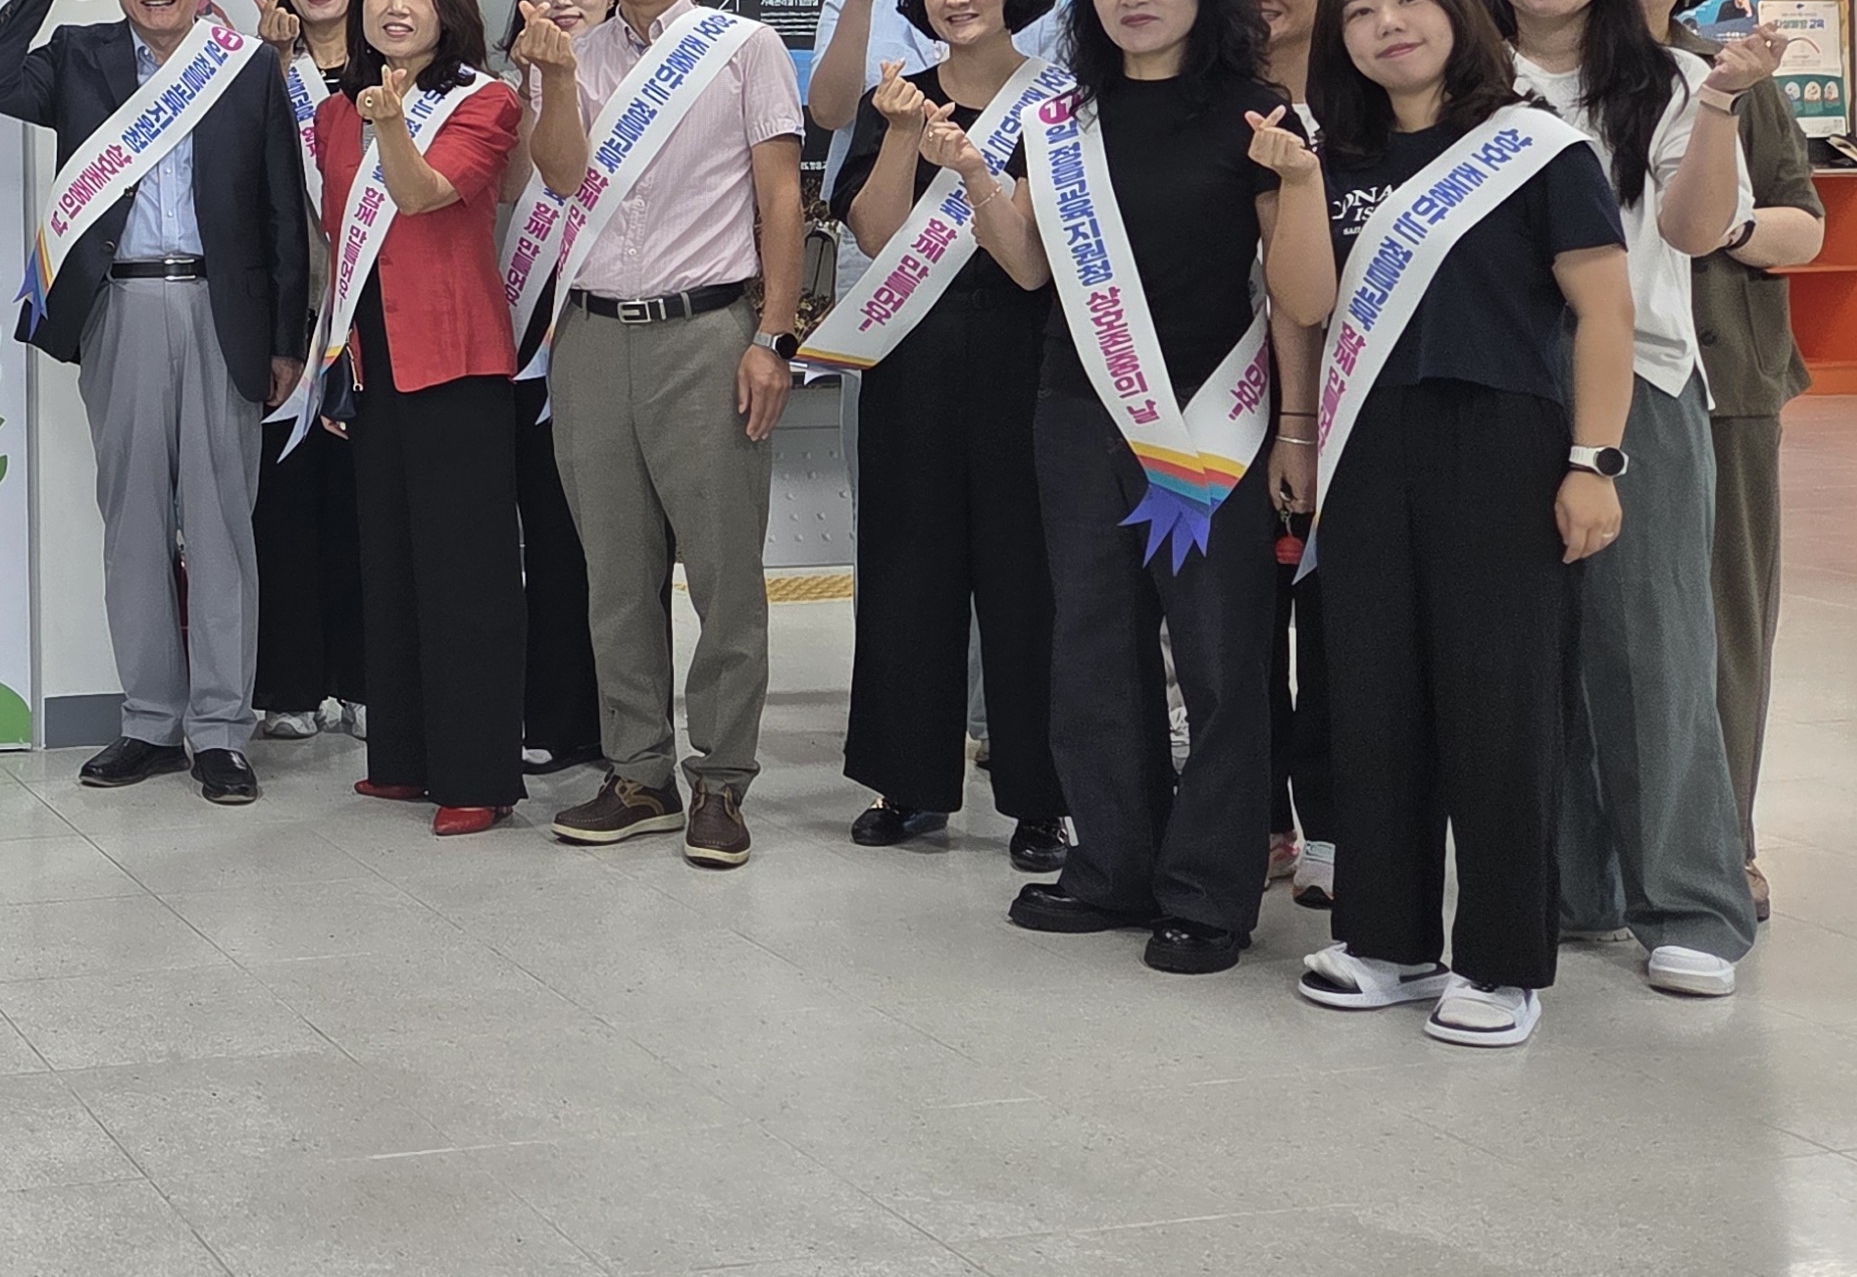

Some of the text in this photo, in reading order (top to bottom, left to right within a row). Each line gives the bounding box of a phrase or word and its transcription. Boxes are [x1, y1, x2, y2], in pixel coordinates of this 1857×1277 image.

[692, 12, 738, 43] 상호
[641, 33, 711, 107] 존중하는
[121, 53, 217, 154] 정읍교육지원청
[595, 97, 659, 175] 정읍교육
[58, 144, 134, 220] 상호존중의
[1470, 127, 1534, 172] 상호
[354, 186, 385, 228] 함께
[524, 201, 560, 242] 함께
[575, 166, 610, 212] 함께
[1392, 159, 1488, 245] 존중하는
[50, 211, 69, 238] 날
[910, 218, 957, 264] 함께
[858, 254, 930, 332] 만들어요!
[1047, 141, 1114, 288] 정읍교육지원청
[1085, 286, 1150, 400] 상호존중의
[1126, 397, 1161, 426] 날
[1347, 235, 1414, 333] 정읍교육
[1333, 320, 1367, 378] 함께
